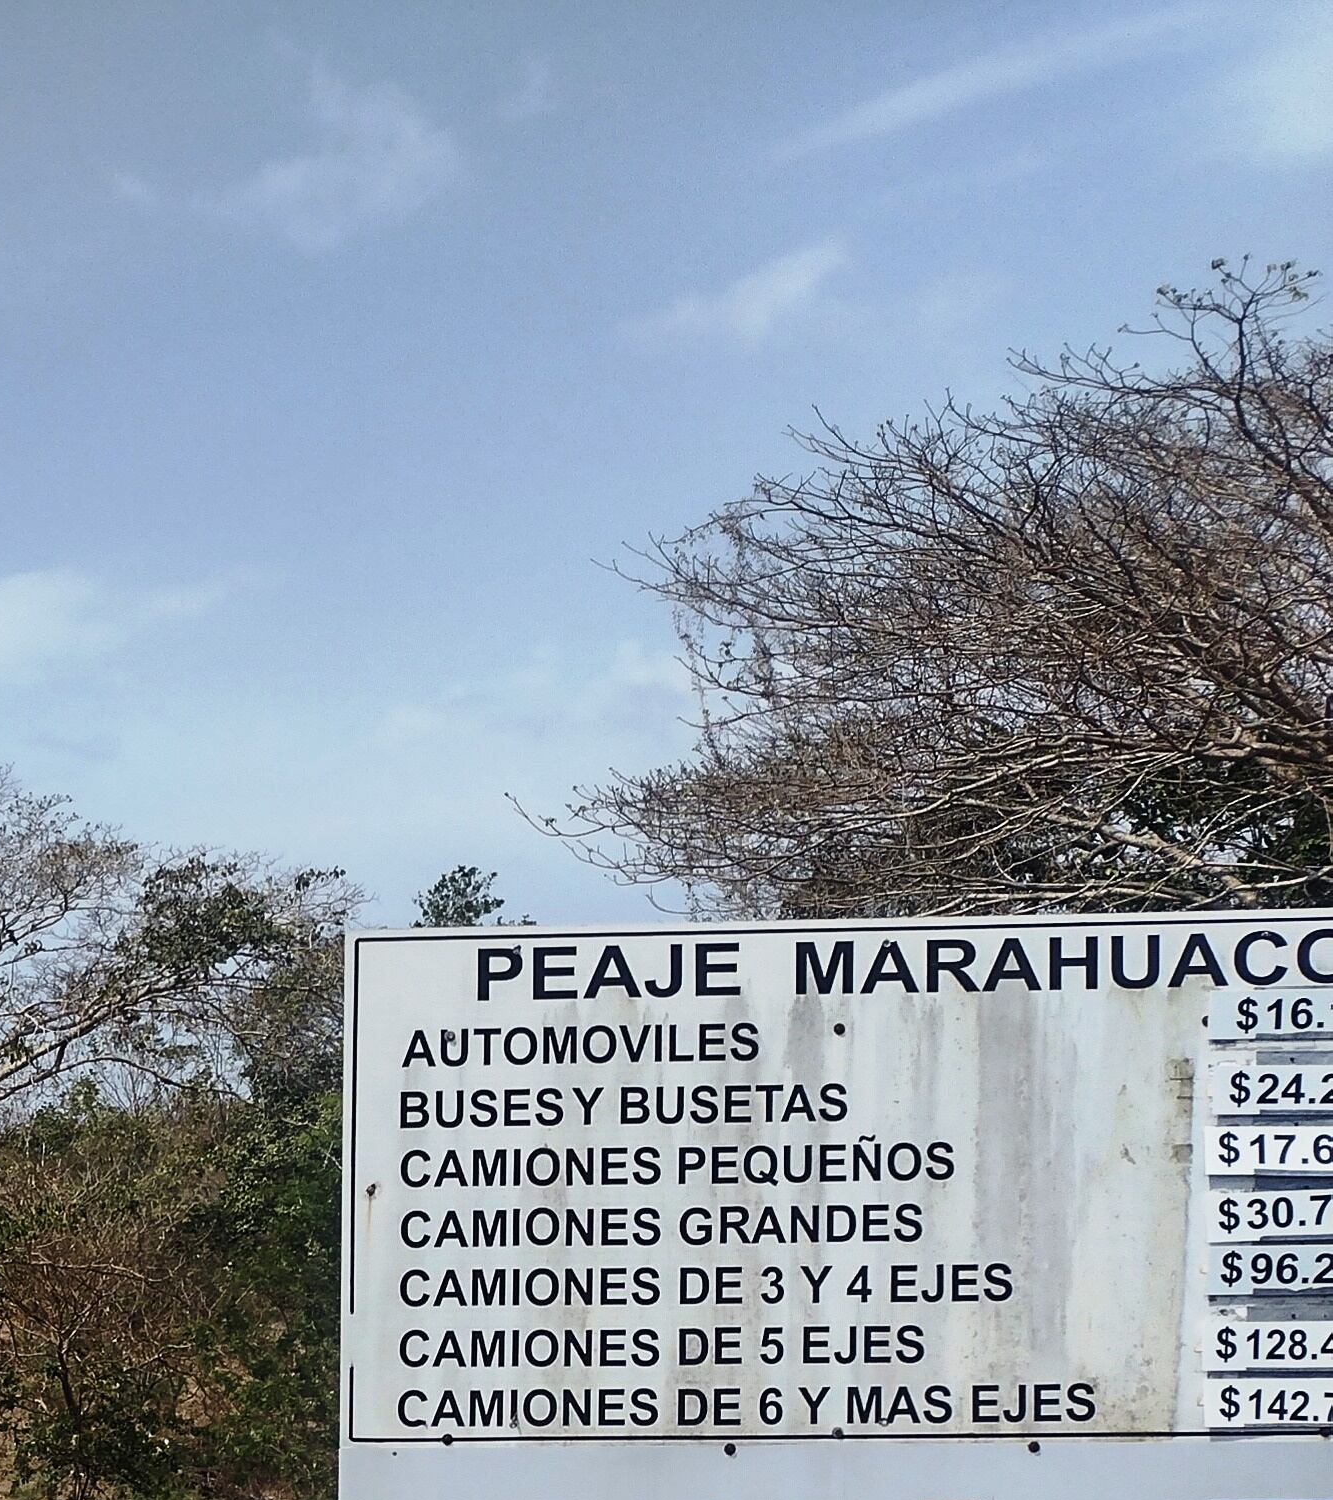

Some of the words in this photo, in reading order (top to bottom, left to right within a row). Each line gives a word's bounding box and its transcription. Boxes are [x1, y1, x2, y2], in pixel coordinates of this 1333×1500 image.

[475, 942, 742, 1001] PEAJE
[794, 928, 1333, 994] MARAHUACO
[402, 1022, 760, 1068] AUTOMOVILES
[399, 1088, 564, 1129] BUSES
[572, 1087, 605, 1126] Y
[620, 1083, 848, 1125] BUSETAS
[399, 1146, 661, 1188] CAMIONES
[678, 1134, 955, 1187] PEQUEÑOS
[1218, 1131, 1333, 1167] $17.6
[399, 1207, 661, 1249] CAMIONES
[679, 1203, 923, 1246] GRANDES
[1218, 1194, 1333, 1234] $30.7
[399, 1267, 661, 1307] CAMIONES
[679, 1266, 743, 1305] DE
[760, 1266, 785, 1305] 3
[800, 1265, 833, 1304] Y
[846, 1265, 872, 1303] 4
[890, 1263, 1014, 1303] EJES
[1220, 1250, 1333, 1288] $96.2
[398, 1328, 660, 1368] CAMIONES
[678, 1327, 743, 1366] DE
[759, 1327, 784, 1365] 5
[802, 1324, 926, 1365] EJES
[397, 1388, 659, 1428] CAMIONES
[677, 1388, 742, 1426] DE
[759, 1387, 783, 1426] 6
[798, 1386, 831, 1425] Y
[846, 1385, 953, 1426] MAS
[971, 1382, 1097, 1424] EJES
